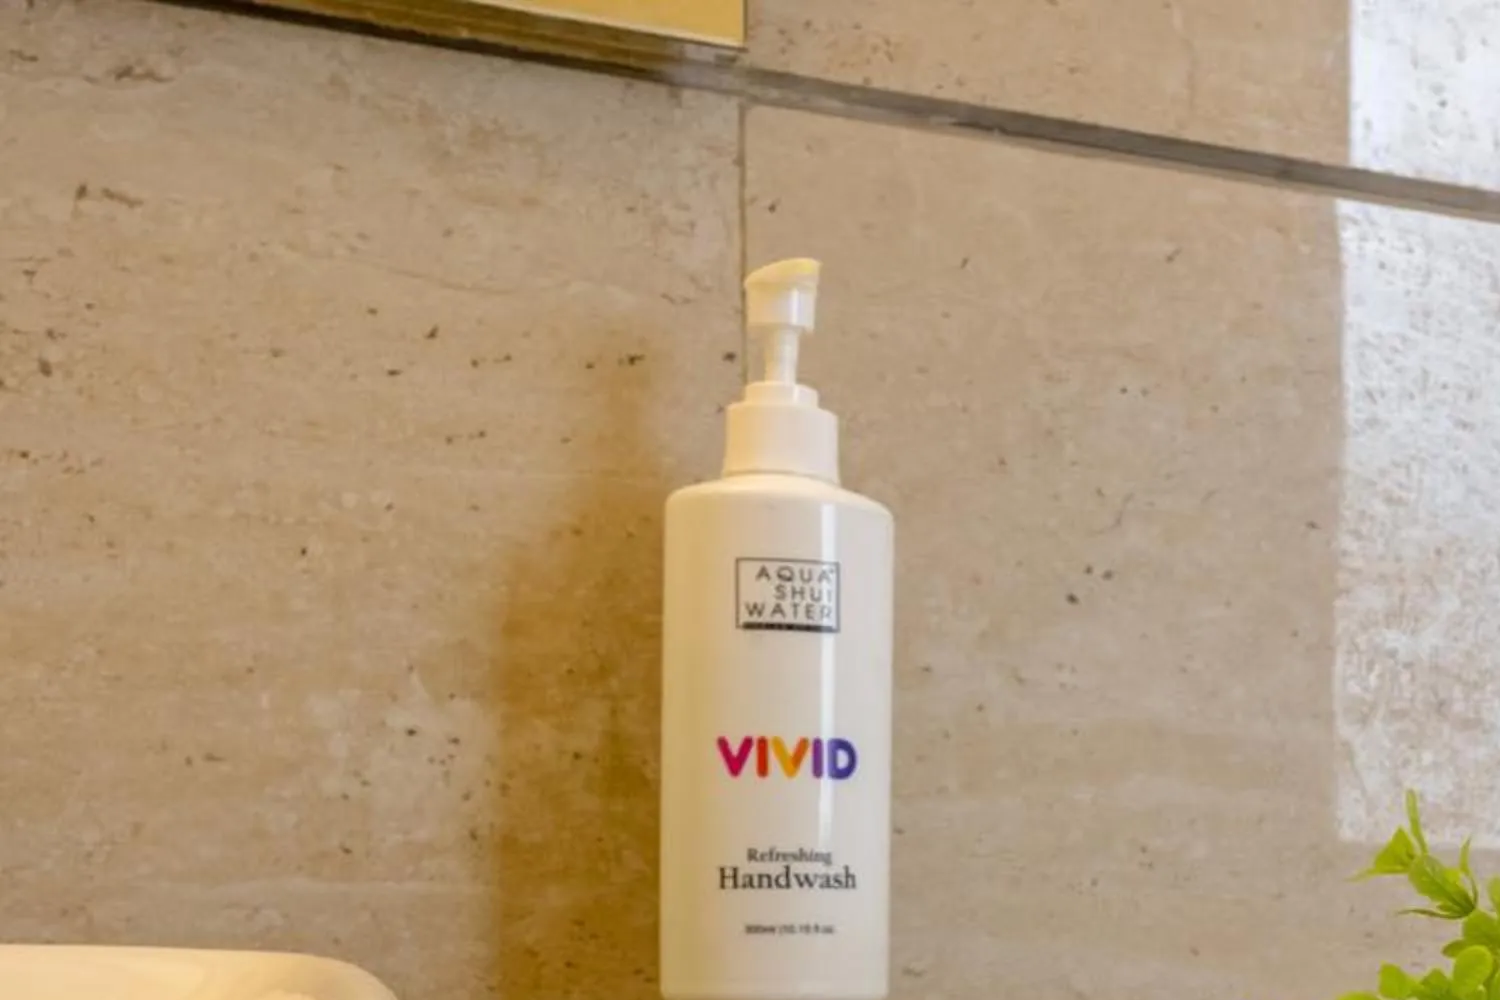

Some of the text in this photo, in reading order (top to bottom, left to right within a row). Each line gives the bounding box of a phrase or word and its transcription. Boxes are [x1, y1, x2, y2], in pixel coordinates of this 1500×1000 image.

[755, 564, 833, 583] AQUA
[774, 583, 832, 603] SHUI
[744, 601, 833, 621] WATER
[717, 735, 858, 781] VIVID
[747, 846, 833, 866] Refreshing
[719, 864, 857, 890] Handwash
